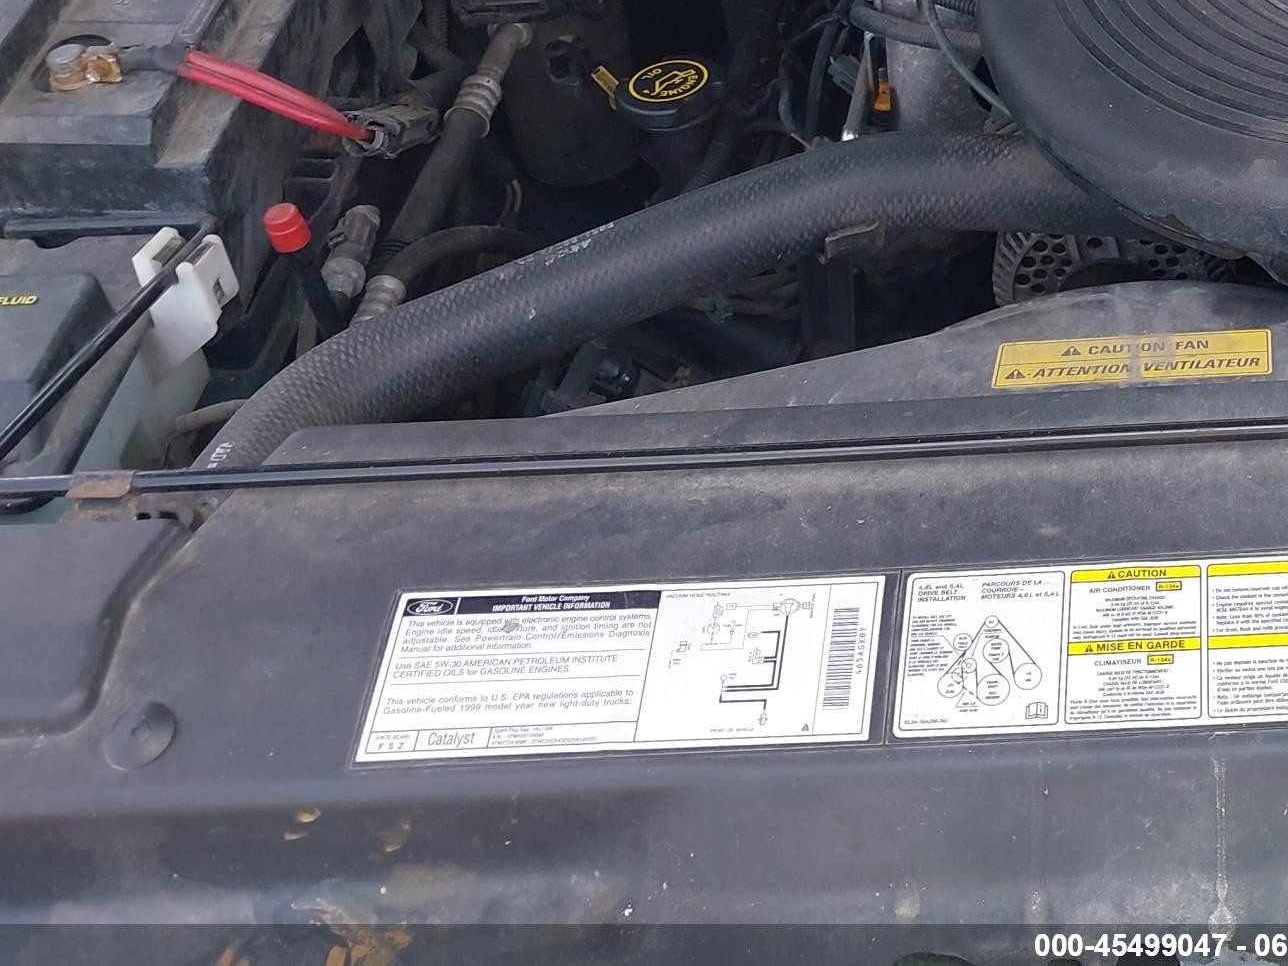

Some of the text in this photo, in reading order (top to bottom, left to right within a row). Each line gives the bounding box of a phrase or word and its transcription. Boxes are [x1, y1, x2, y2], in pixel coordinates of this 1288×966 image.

[640, 68, 663, 79] OIL
[659, 75, 698, 97] ENGINE
[1175, 339, 1209, 351] FAN
[1143, 356, 1261, 372] VENTILATEUR
[1118, 569, 1167, 577] CAUTION
[492, 603, 533, 612] IMPORTANT
[564, 601, 611, 609] INFORMATION
[466, 618, 502, 626] equipped
[561, 623, 591, 631] ignition
[594, 622, 618, 630] timing
[526, 631, 604, 640] Control/Emissions
[1096, 640, 1185, 651] MISE EN GARDE
[395, 662, 412, 670] Use
[463, 658, 512, 667] AMERICAN
[513, 656, 570, 665] PETROLEUM
[571, 655, 618, 663] INSTITUTE
[393, 670, 441, 679] CERTIFIED
[443, 669, 465, 677] OILS
[480, 666, 526, 675] GASOLINE
[439, 695, 477, 703] conforms
[512, 692, 530, 700] EPA
[533, 691, 578, 700] regulations
[581, 689, 622, 700] applicable
[384, 705, 455, 714] Gasoline-Fueled
[460, 703, 481, 711] 1999
[485, 702, 512, 711] model
[515, 703, 535, 711] year
[560, 700, 599, 709] light-duty
[428, 731, 475, 748] Catalyst
